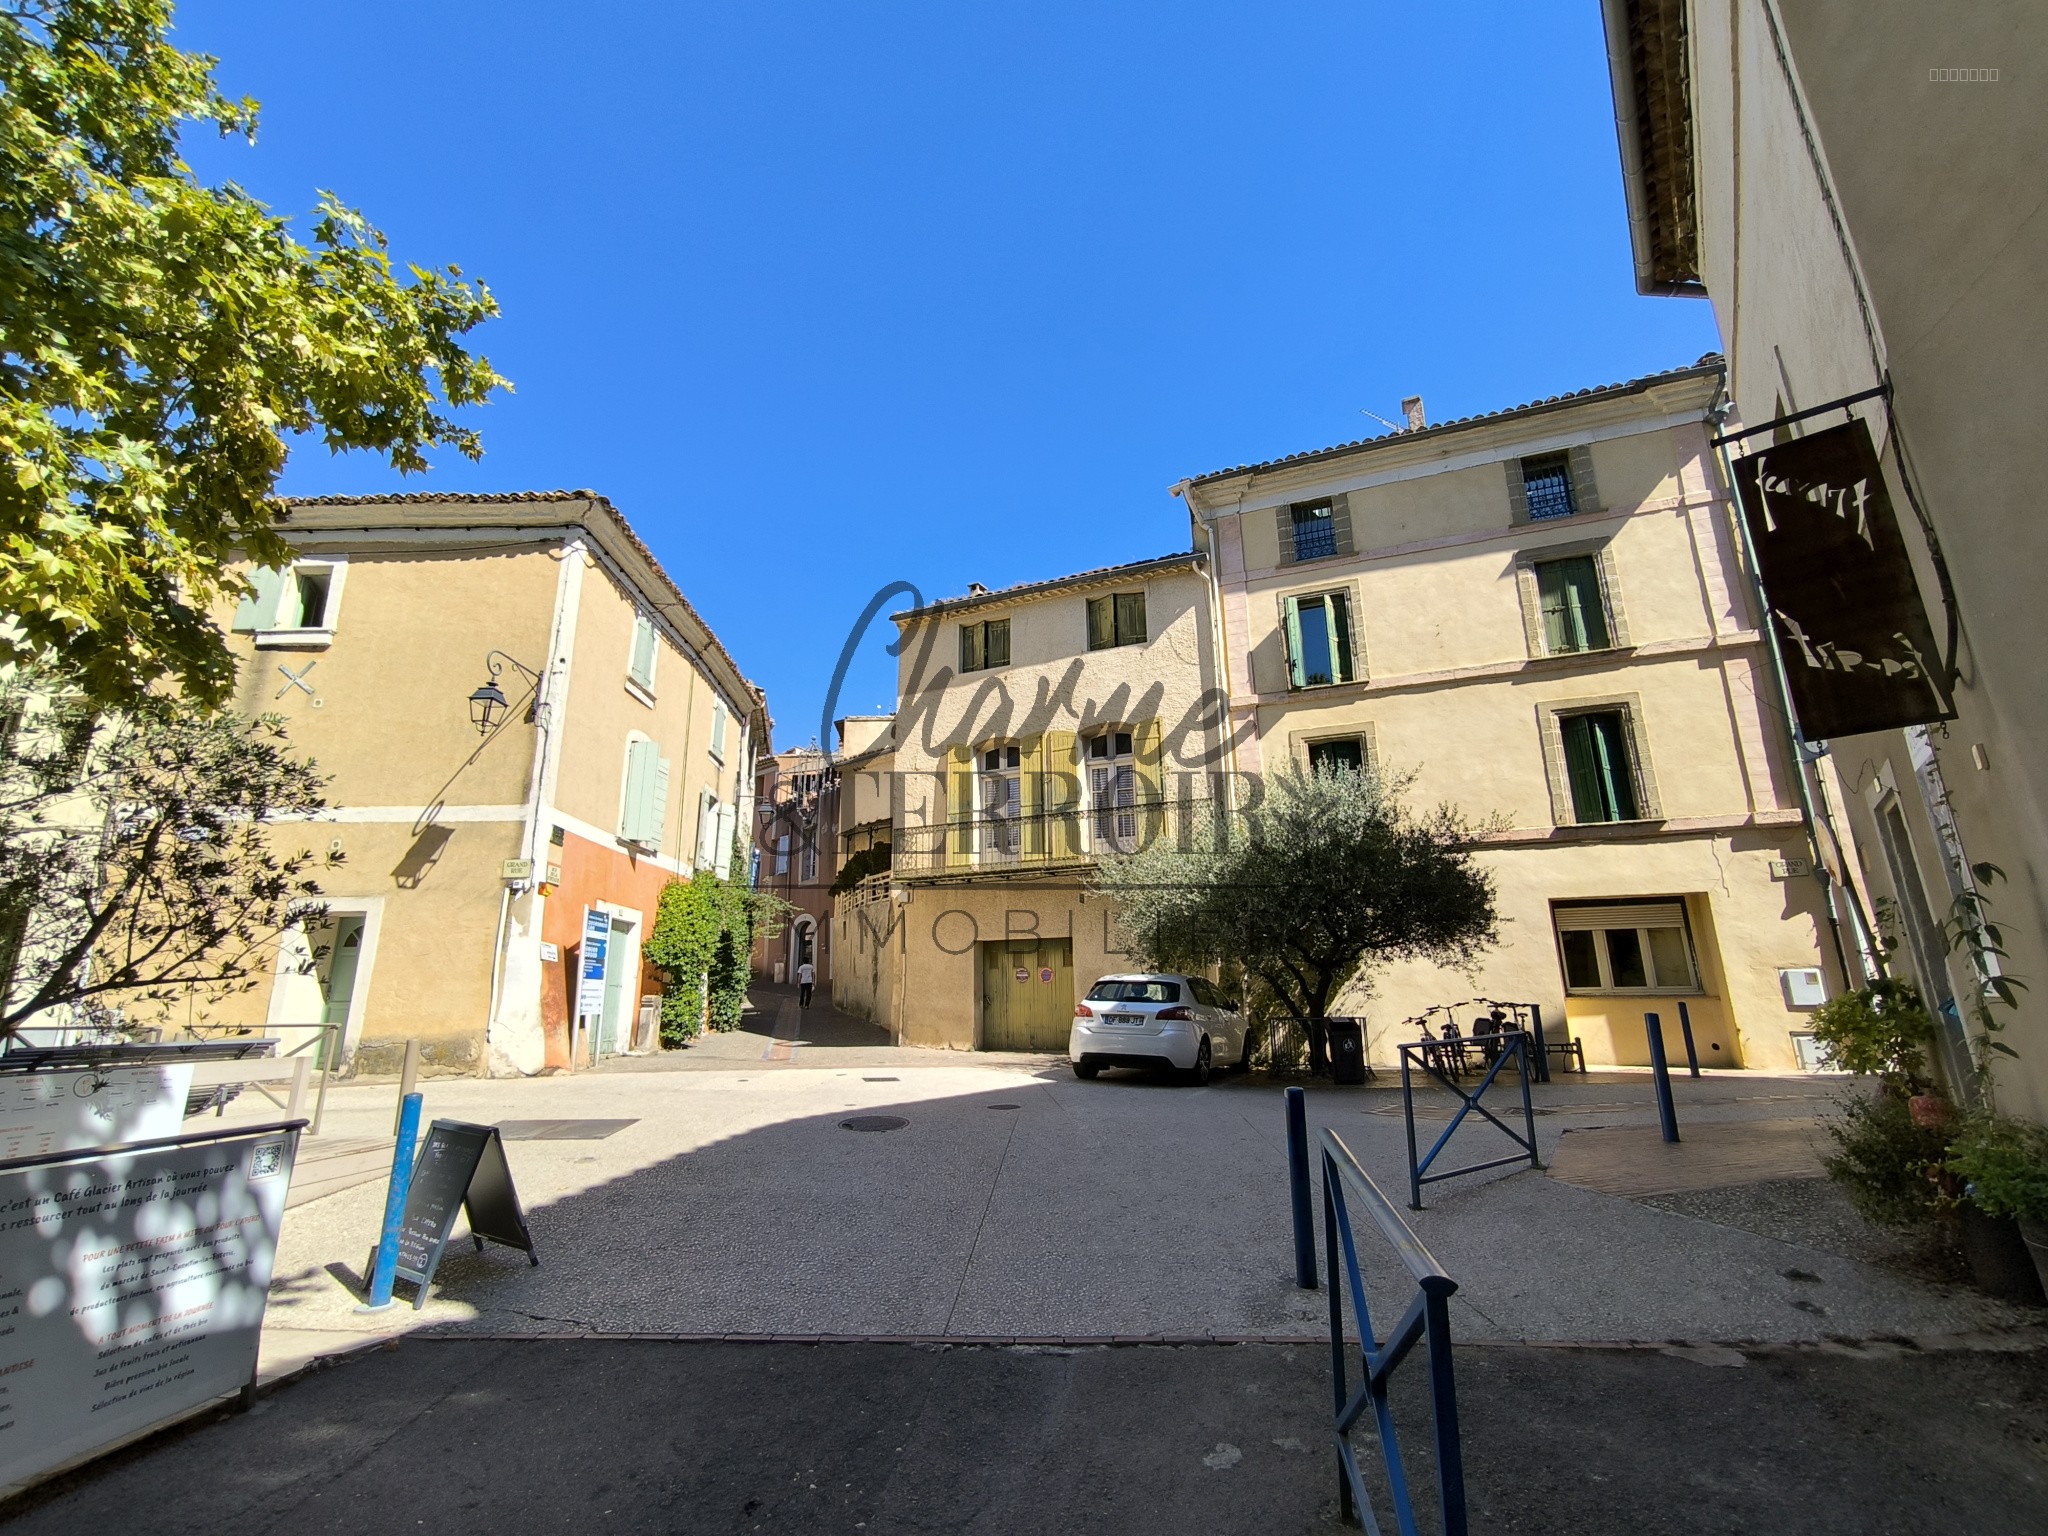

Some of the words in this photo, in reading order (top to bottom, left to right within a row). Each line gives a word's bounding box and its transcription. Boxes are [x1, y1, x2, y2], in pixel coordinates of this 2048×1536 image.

[34, 1197, 50, 1207] un
[54, 1188, 82, 1202] Café
[84, 1182, 122, 1197] Glacier
[125, 1176, 163, 1190] Artisan
[166, 1172, 178, 1182] où
[180, 1170, 201, 1180] vous
[203, 1164, 235, 1178] pouvez
[10, 1209, 74, 1230] ressourcer
[77, 1203, 103, 1216] tout
[104, 1201, 118, 1211] au
[121, 1195, 143, 1207] long
[145, 1191, 158, 1202] de
[160, 1189, 170, 1199] la
[169, 1183, 208, 1200] journée
[83, 1249, 106, 1262] POUR
[107, 1246, 125, 1257] UNE
[126, 1238, 153, 1252] PETITE
[155, 1234, 175, 1246] FAIM
[102, 1264, 115, 1273] Les
[116, 1258, 135, 1272] plats
[138, 1253, 153, 1263] sont
[213, 1233, 240, 1247] produits
[112, 1274, 139, 1287] marché
[140, 1271, 149, 1280] de
[69, 1307, 79, 1316] de
[81, 1294, 128, 1315] producteurs
[156, 1284, 165, 1292] en
[97, 1343, 132, 1360] Sélection
[133, 1339, 143, 1348] de
[144, 1331, 163, 1344] cafés
[164, 1328, 172, 1338] et
[173, 1325, 182, 1335] de
[198, 1317, 209, 1327] bio
[107, 1327, 127, 1341] TOUT
[128, 1317, 162, 1335] MOMENT
[163, 1313, 173, 1323] DE
[174, 1311, 183, 1321] LA
[94, 1367, 107, 1378] Jus
[109, 1362, 119, 1373] de
[120, 1355, 142, 1369] fruits
[143, 1349, 160, 1362] frais
[161, 1345, 170, 1354] et
[104, 1378, 124, 1391] Bière
[125, 1367, 156, 1386] pression
[157, 1362, 168, 1373] bio
[169, 1353, 190, 1367] locale
[91, 1394, 128, 1413] Sélection
[128, 1389, 138, 1399] de
[140, 1383, 155, 1394] vins
[155, 1379, 164, 1389] de
[165, 1376, 173, 1385] la
[173, 1368, 195, 1383] région
